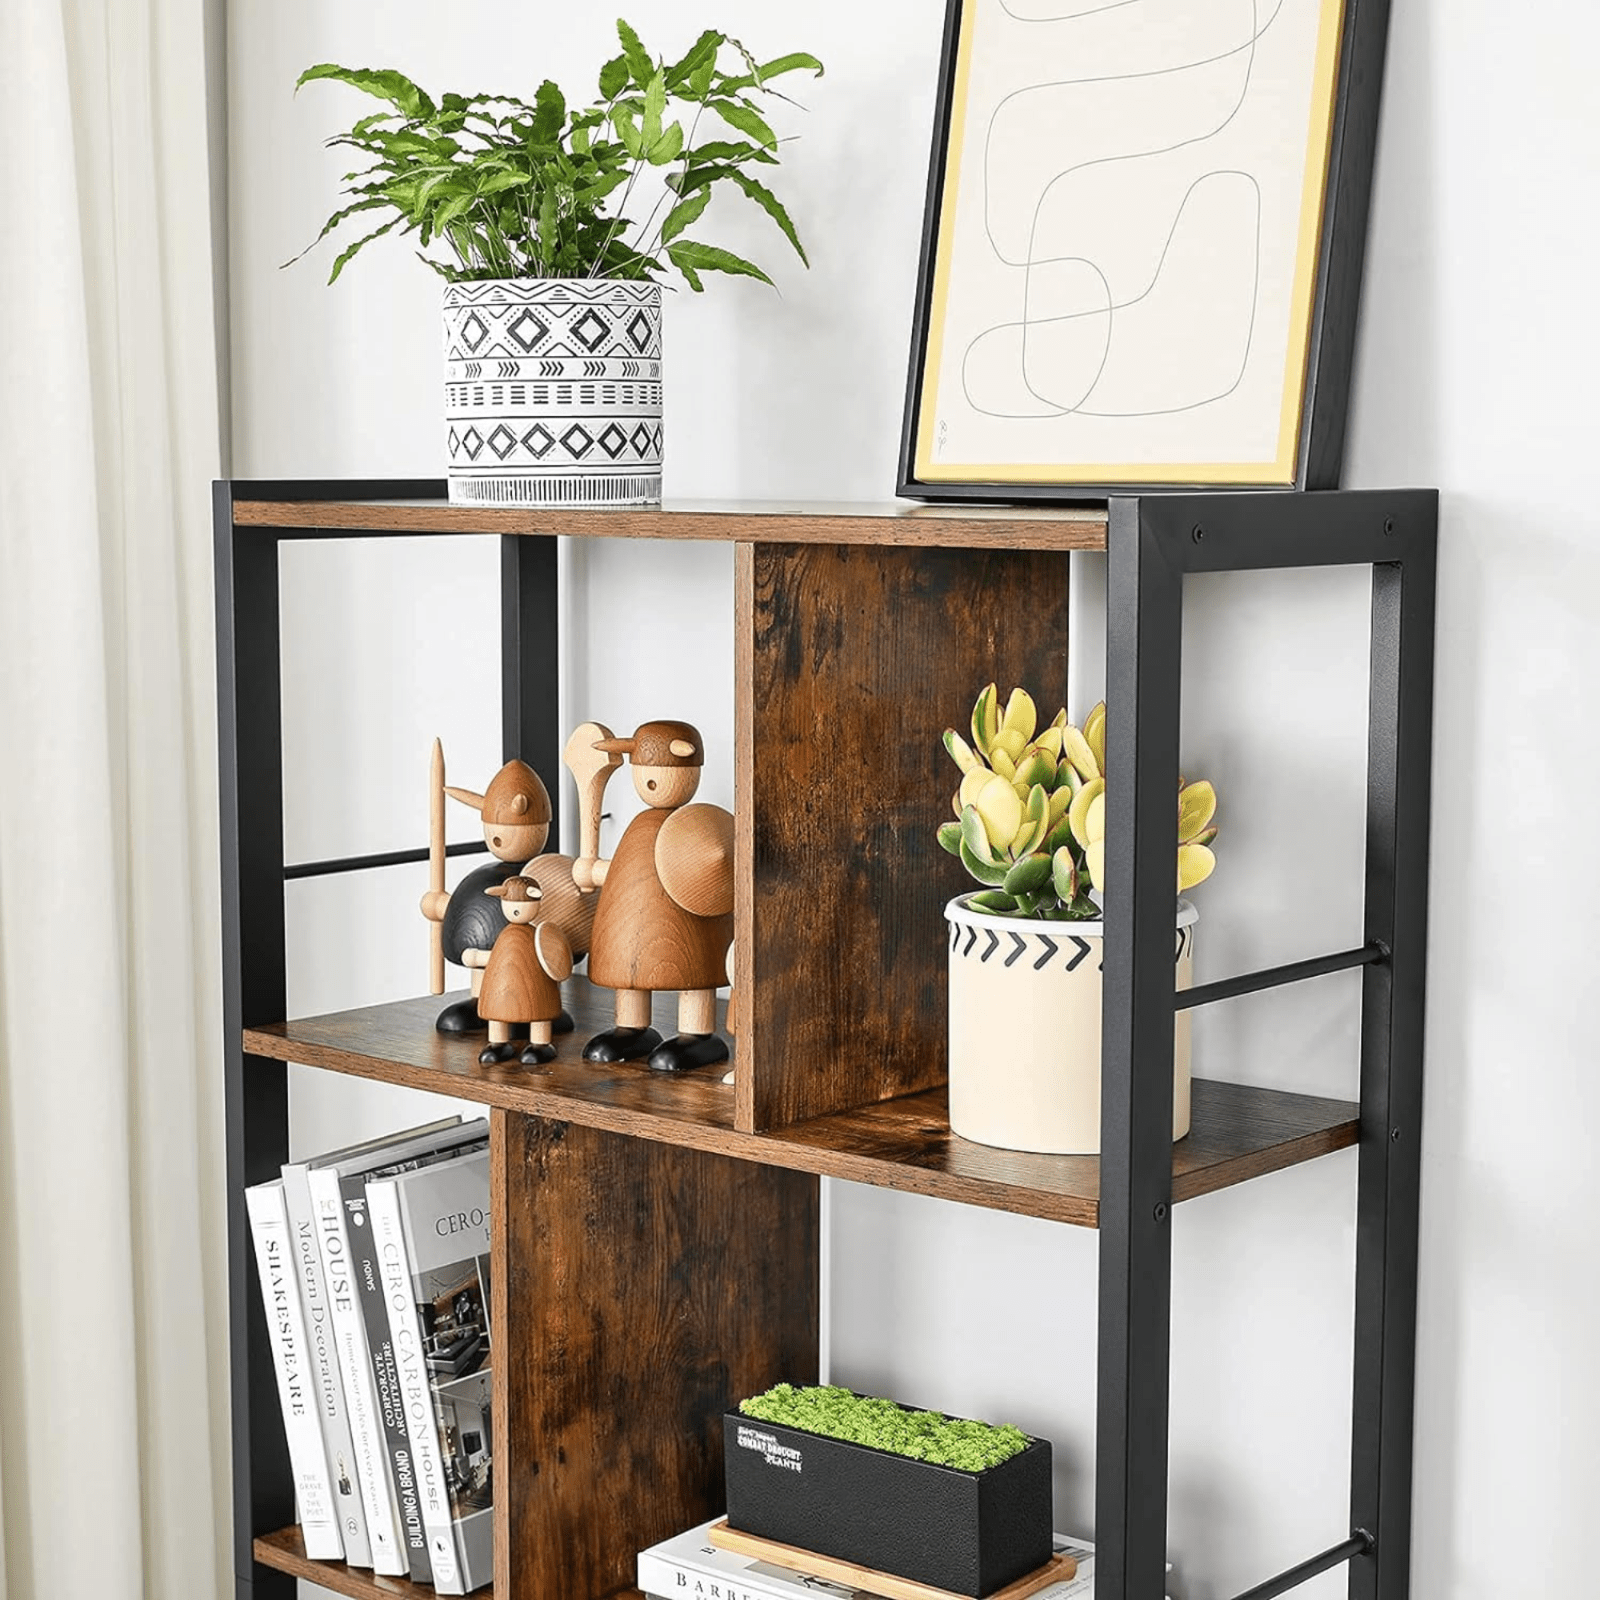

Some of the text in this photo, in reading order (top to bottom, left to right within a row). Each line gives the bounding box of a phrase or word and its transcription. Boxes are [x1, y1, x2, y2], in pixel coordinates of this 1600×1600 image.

[322, 1216, 352, 1312] HOUSE
[363, 1259, 376, 1291] SANDU
[266, 1240, 305, 1416] SHAKESPEARE
[298, 1221, 337, 1417] Modern Decoration
[345, 1332, 355, 1364] Home
[374, 1352, 395, 1427] CORPORATE
[382, 1341, 406, 1436] ARCHITECTURE
[384, 1243, 429, 1440] CERO-CARBON
[420, 1445, 439, 1511] HOUSE
